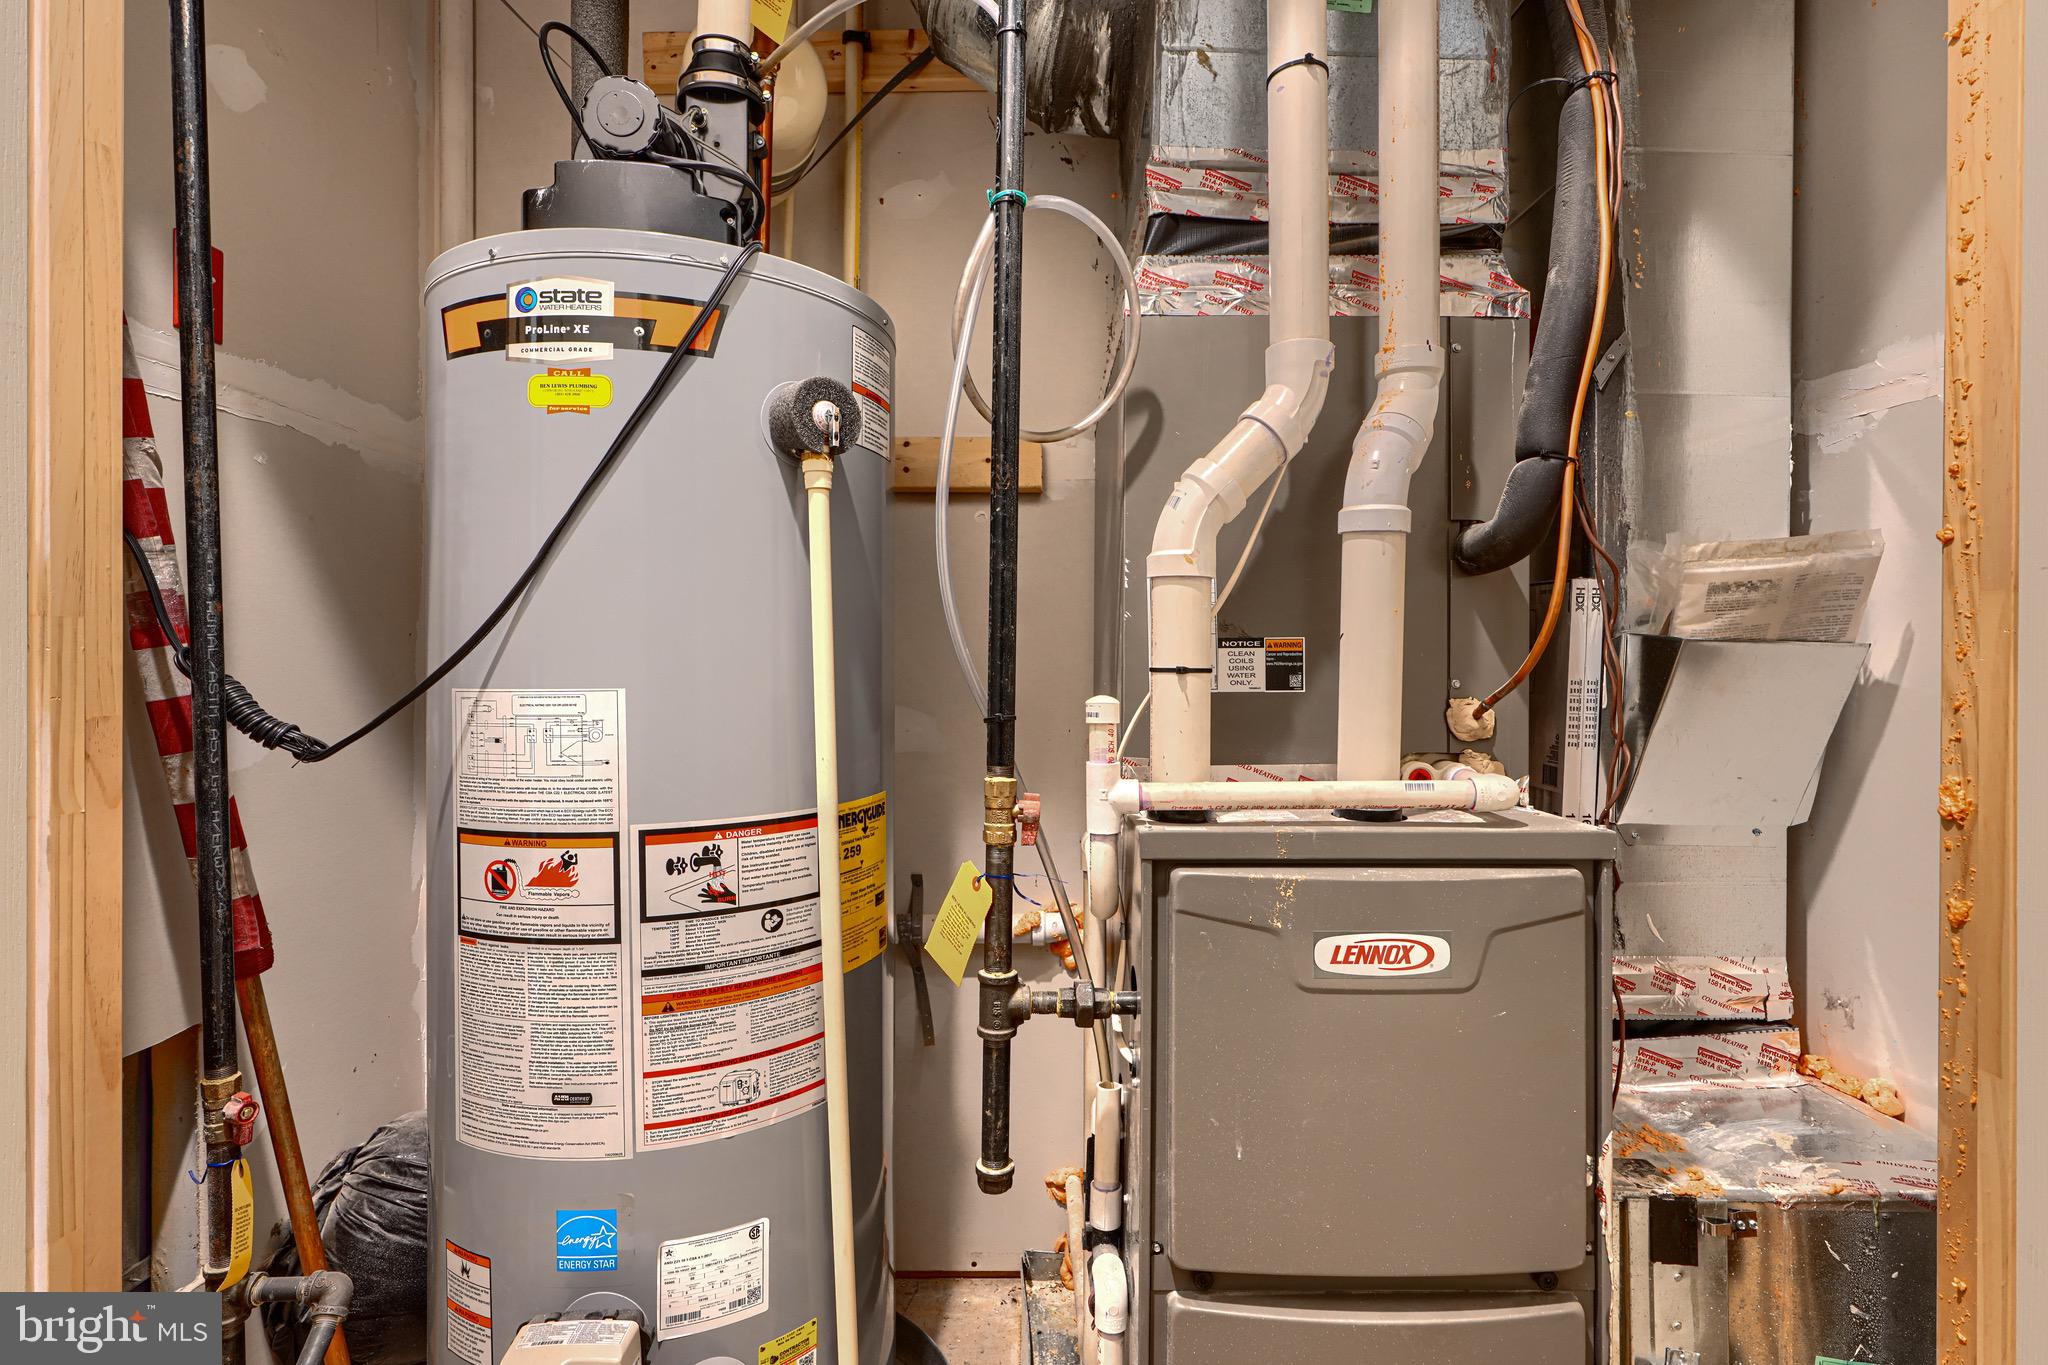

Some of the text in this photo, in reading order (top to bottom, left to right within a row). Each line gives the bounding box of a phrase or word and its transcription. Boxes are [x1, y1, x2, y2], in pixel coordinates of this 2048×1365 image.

[1204, 170, 1252, 192] VentureTape
[539, 288, 602, 304] state
[573, 325, 590, 334] XE
[1575, 587, 1586, 612] HDX
[1591, 587, 1601, 612] HDX
[1107, 728, 1115, 737] 40
[1252, 769, 1284, 782] WEATHER
[839, 802, 886, 829] NERGYGUIDE
[725, 828, 762, 839] DANGER
[511, 839, 547, 847] WARNING
[843, 844, 861, 860] 259
[717, 895, 736, 903] BURN
[1329, 944, 1415, 965] LENNOX
[1729, 959, 1757, 973] WEATHER
[1652, 975, 1672, 987] 181A-P
[1654, 969, 1696, 991] VentureTape
[1707, 979, 1727, 991] 1581A
[1710, 972, 1753, 993] VentureTape
[1701, 995, 1741, 1014] COLD WEATHER
[1721, 1037, 1749, 1050] WEATHER
[1635, 1056, 1656, 1067] 181A-P
[1638, 1050, 1683, 1070] VentureTape
[1698, 1049, 1742, 1071] VentureTape
[1760, 1045, 1798, 1067] VentureTap
[1633, 1063, 1658, 1076] 181B-FX
[1695, 1057, 1715, 1070] 1581A
[558, 1235, 598, 1250] energy
[559, 1259, 615, 1269] ENERGY STAR
